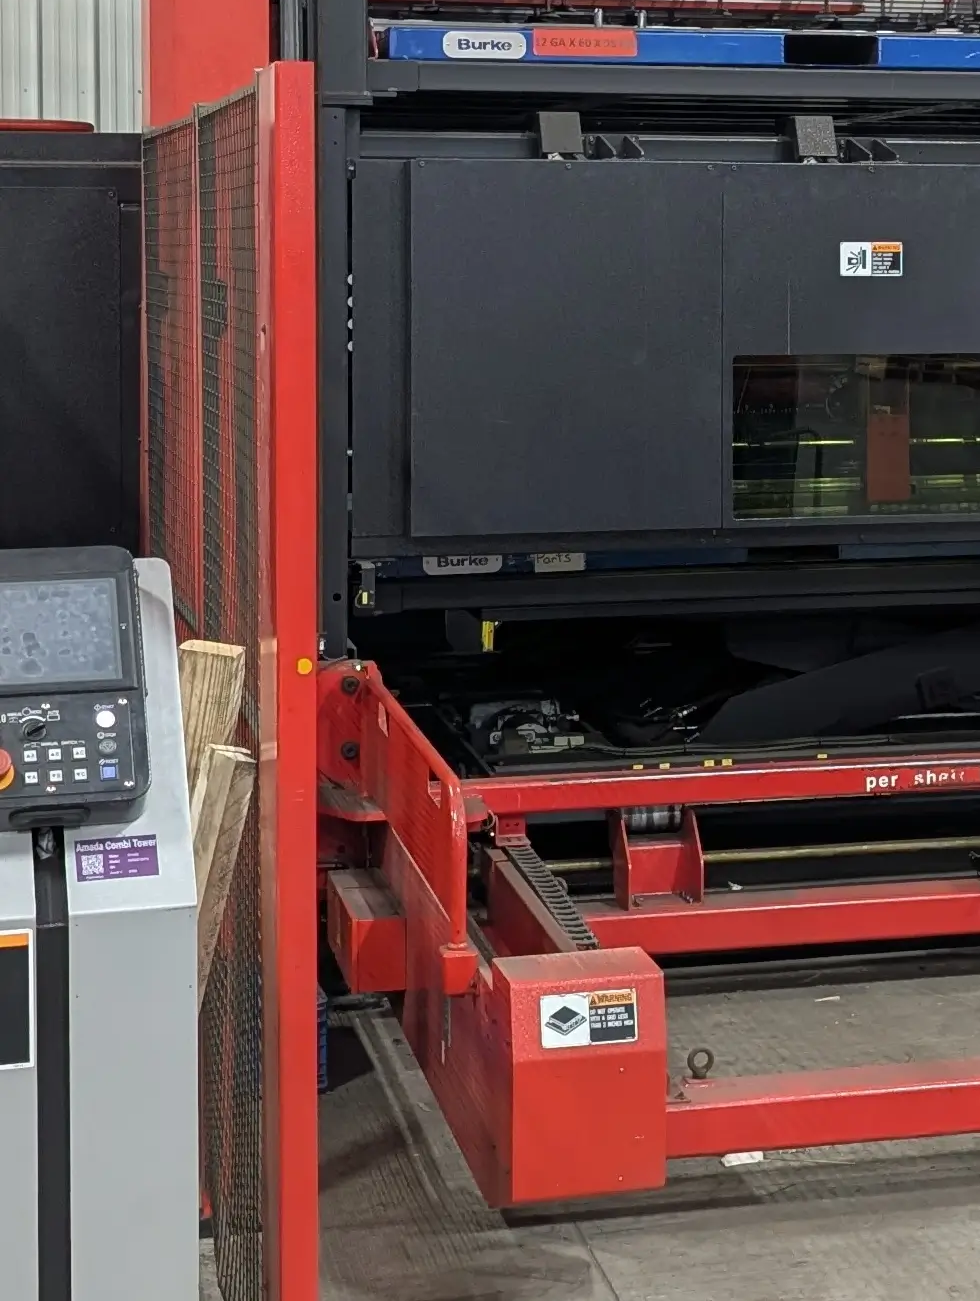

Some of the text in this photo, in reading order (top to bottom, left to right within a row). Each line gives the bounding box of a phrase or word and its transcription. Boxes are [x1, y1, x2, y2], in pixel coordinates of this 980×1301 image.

[457, 38, 512, 52] Burke
[550, 37, 566, 47] GA
[437, 555, 489, 568] Burke
[536, 553, 572, 565] Parts
[865, 774, 899, 792] per
[76, 841, 104, 853] Amada
[105, 839, 132, 851] Combi
